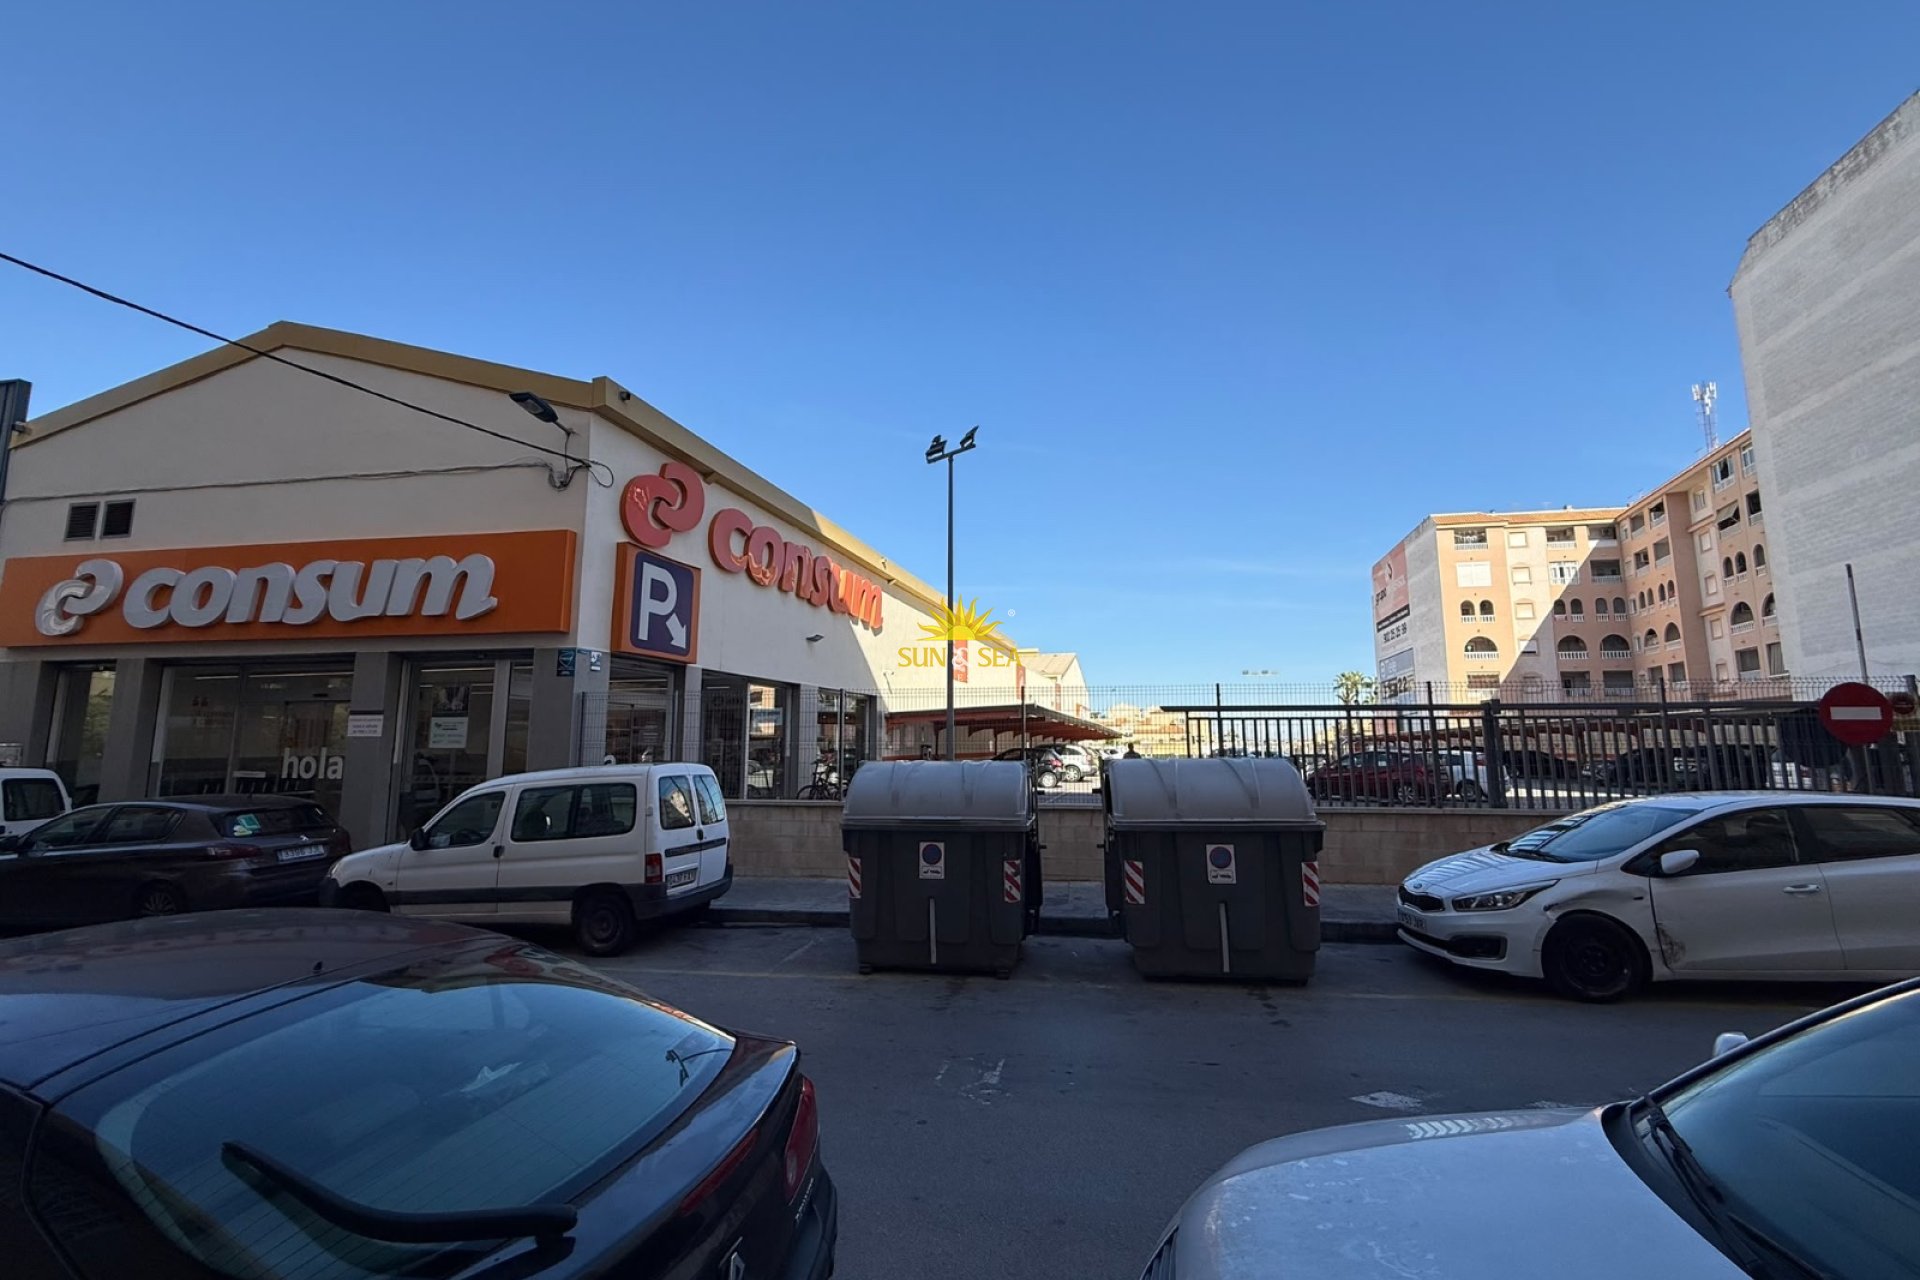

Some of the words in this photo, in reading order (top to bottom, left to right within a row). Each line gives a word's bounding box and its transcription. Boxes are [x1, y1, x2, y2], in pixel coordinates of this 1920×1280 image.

[123, 553, 498, 629] consum
[638, 562, 677, 640] P
[708, 508, 883, 628] consum
[281, 747, 343, 779] hola
